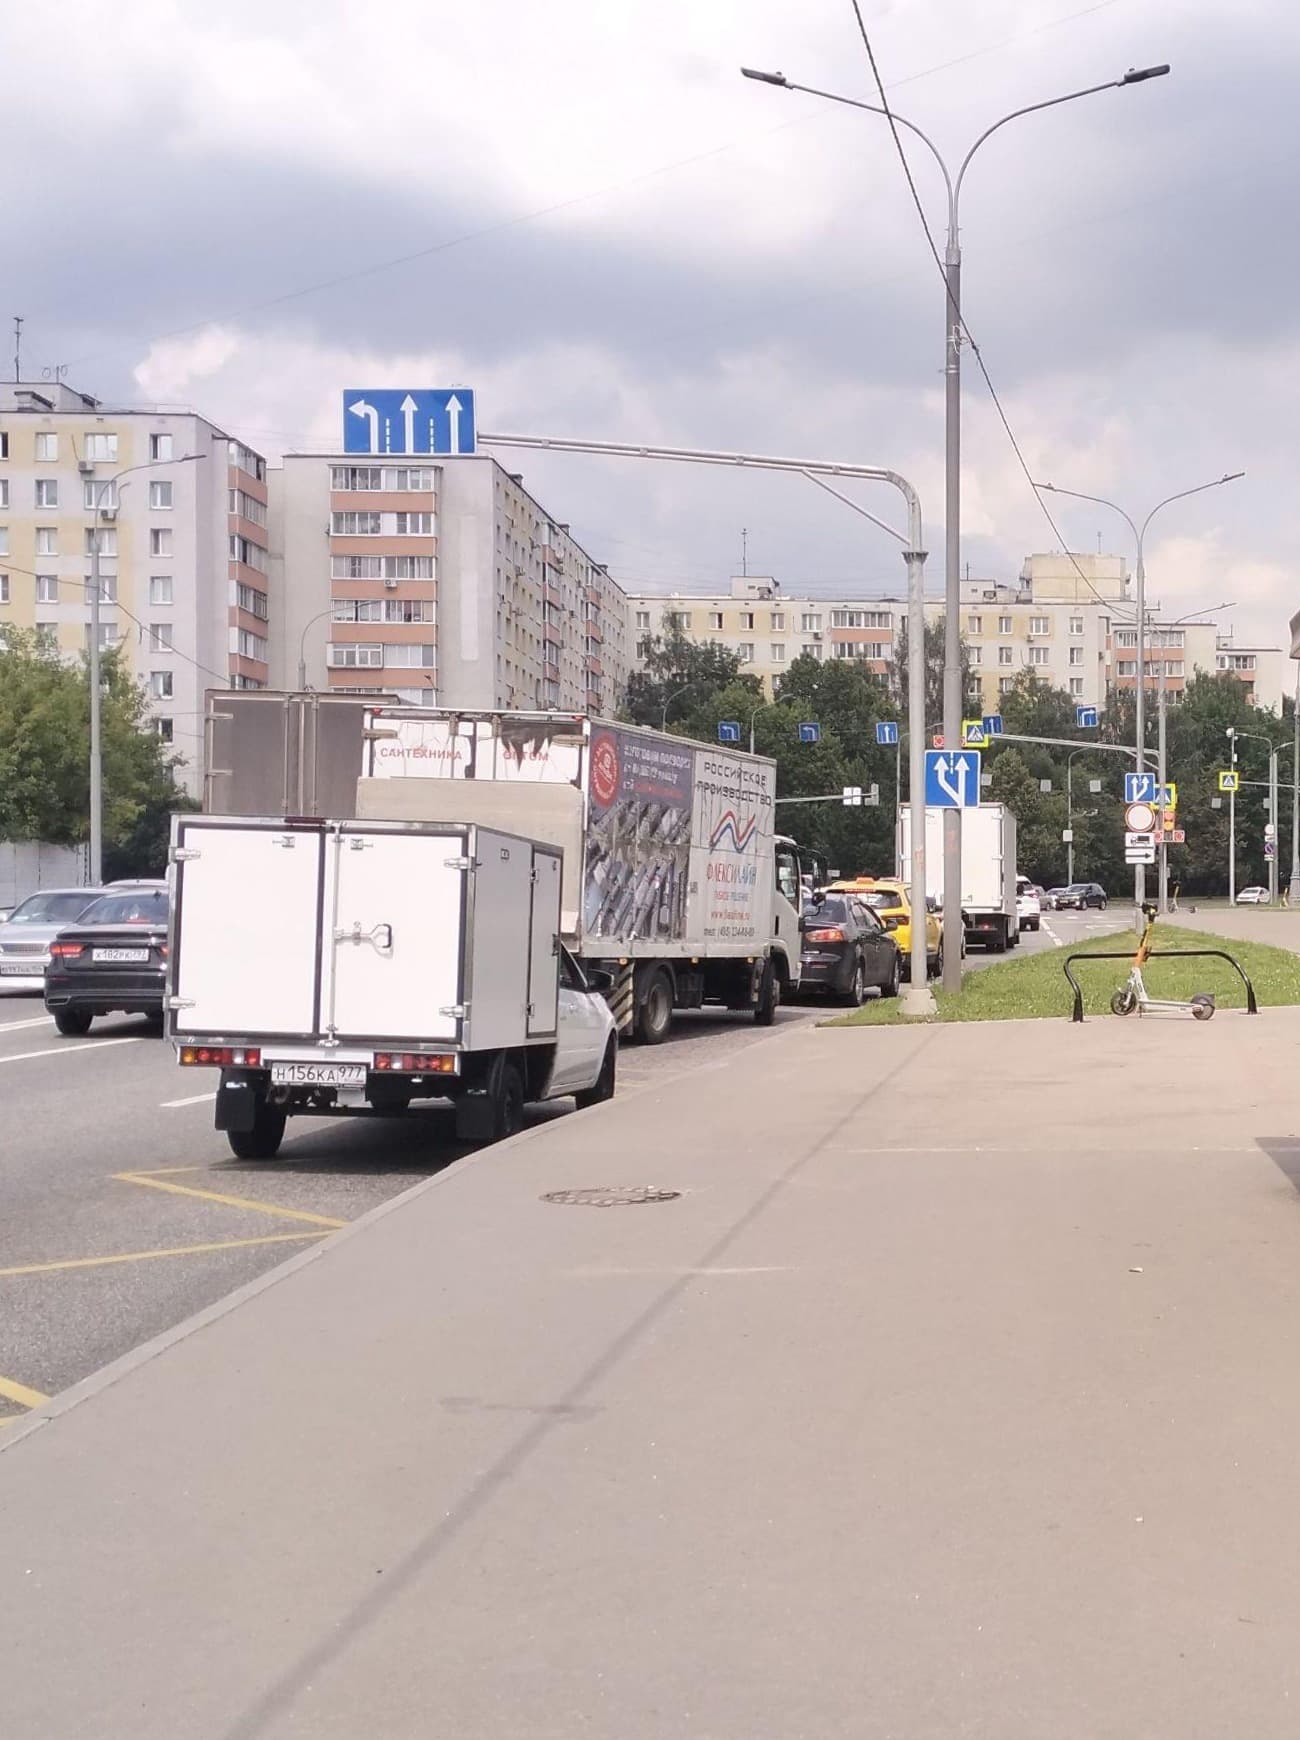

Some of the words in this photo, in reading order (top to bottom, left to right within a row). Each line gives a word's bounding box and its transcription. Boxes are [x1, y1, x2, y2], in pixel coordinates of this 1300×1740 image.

[379, 747, 463, 761] САНТЕХНИКА
[704, 761, 767, 787] РОССИЙСКОЕ
[696, 780, 772, 806] ПРОИЗВОДСТВО
